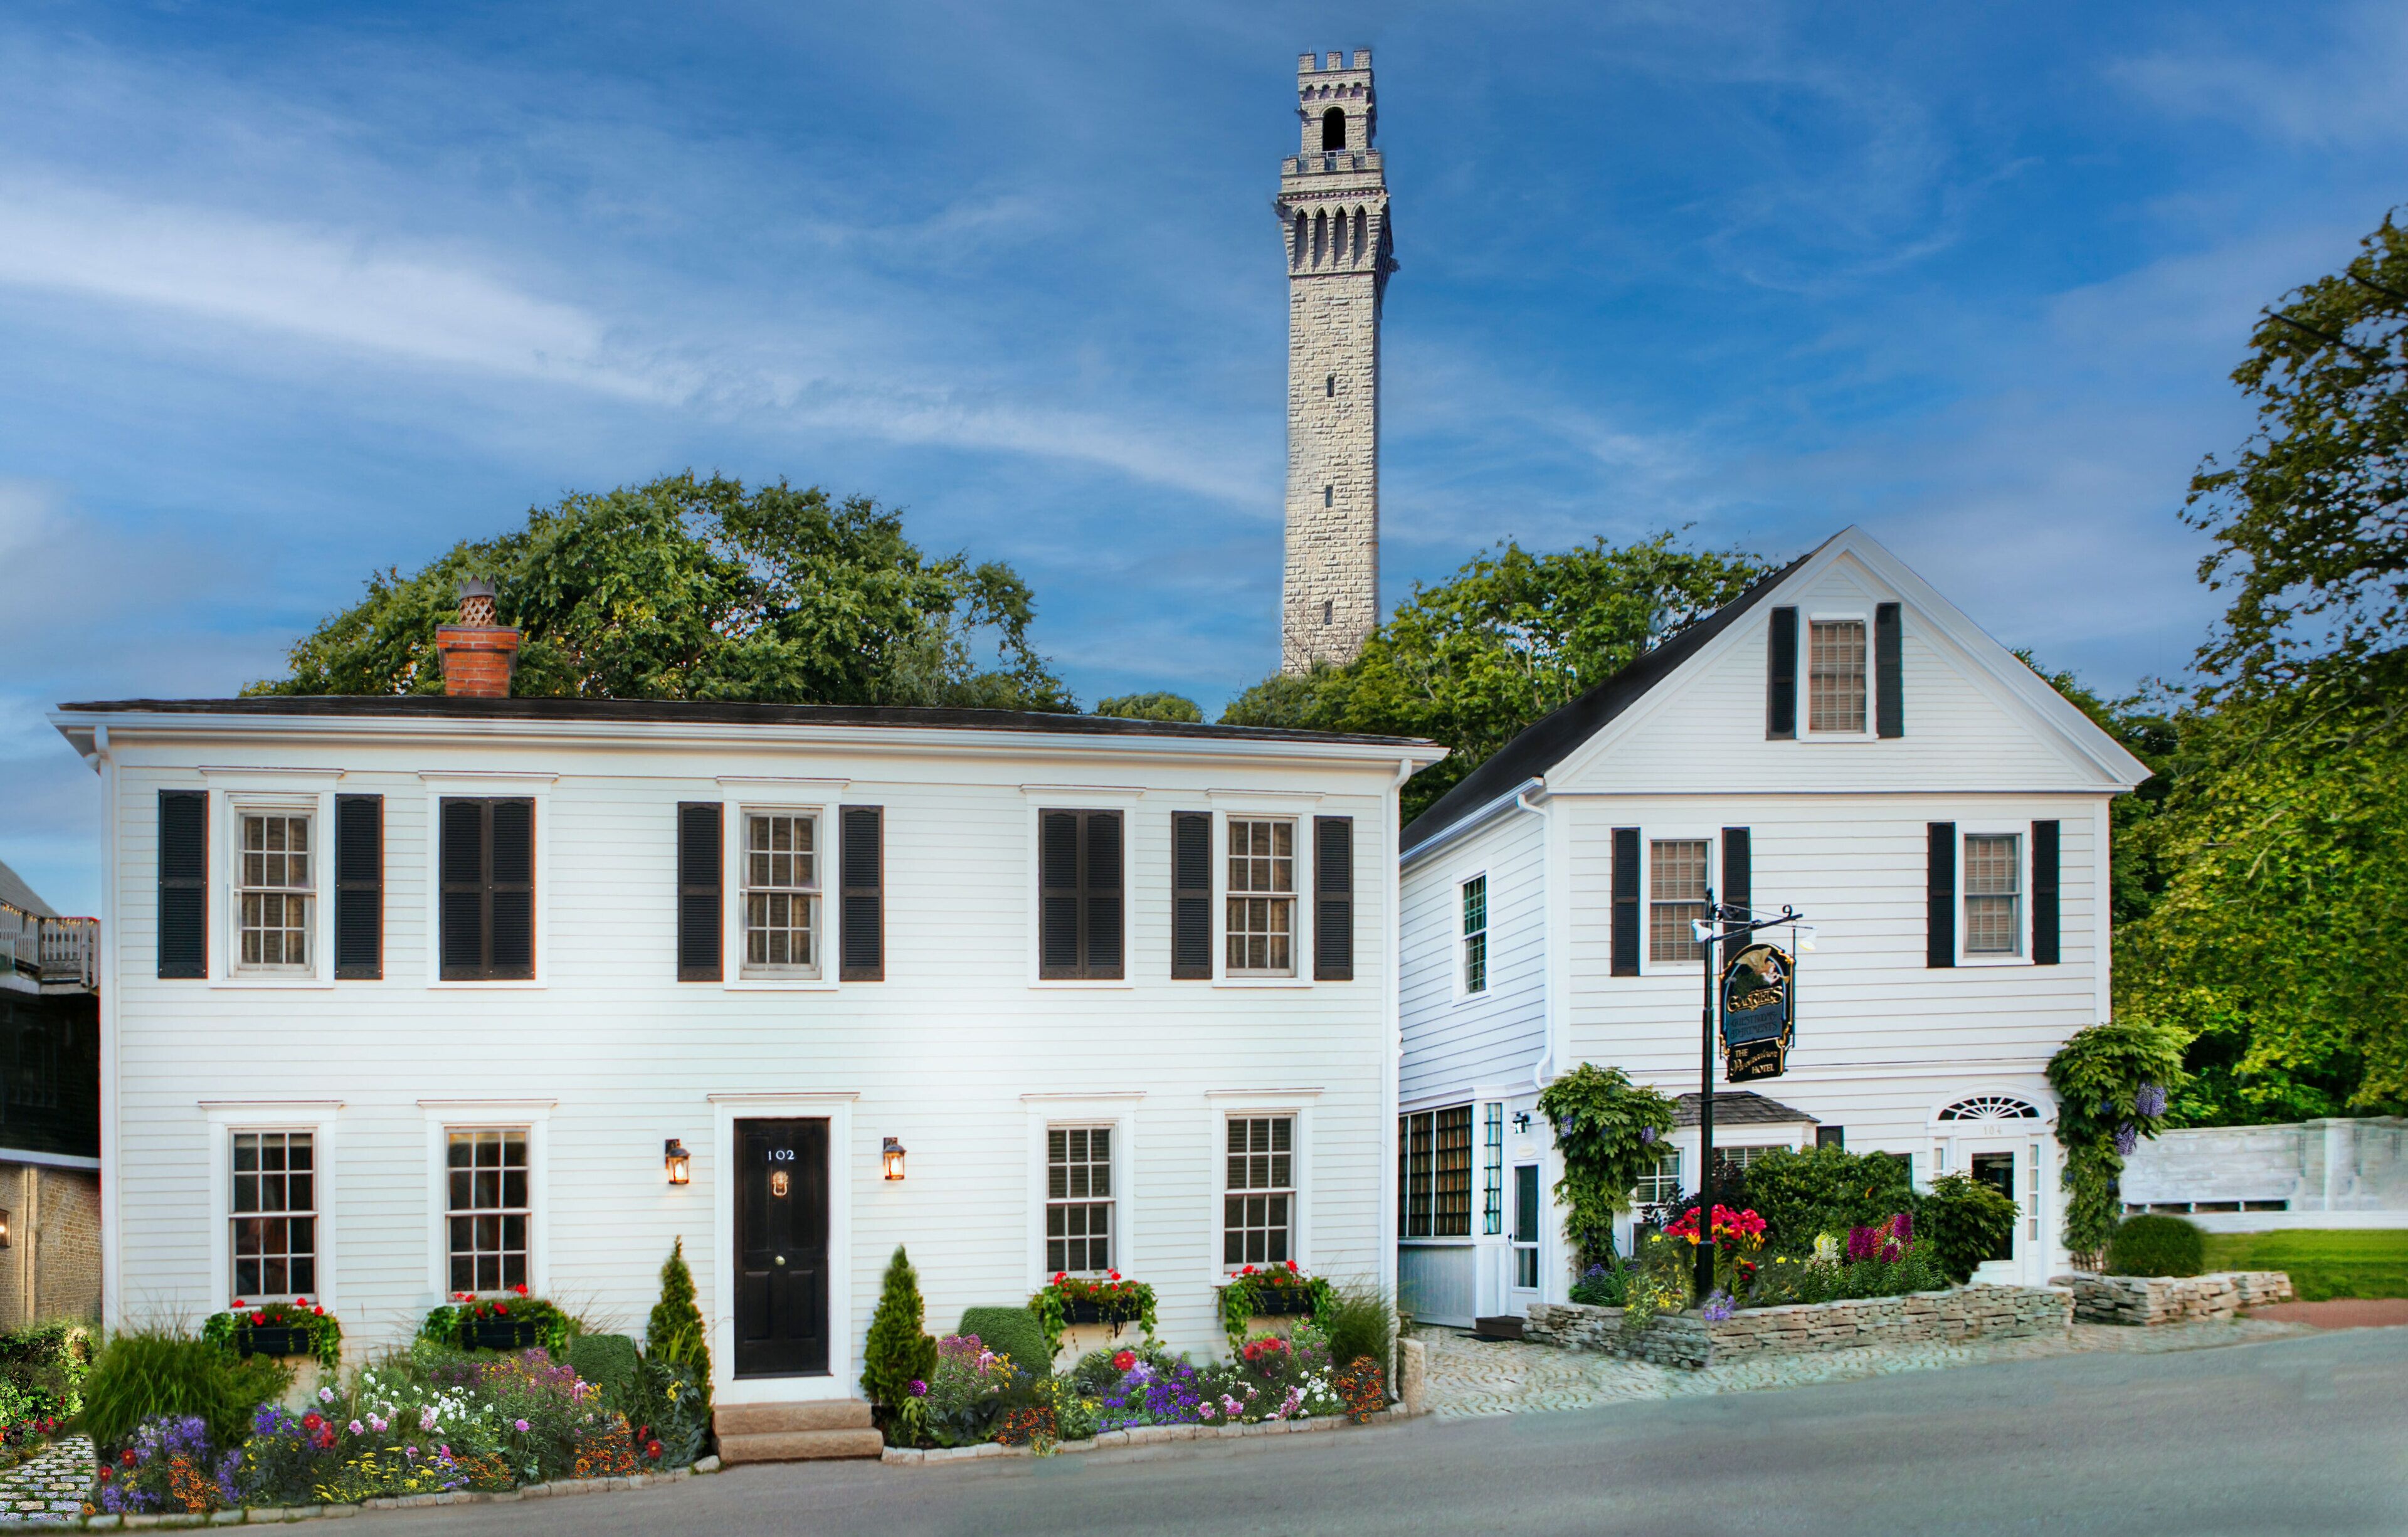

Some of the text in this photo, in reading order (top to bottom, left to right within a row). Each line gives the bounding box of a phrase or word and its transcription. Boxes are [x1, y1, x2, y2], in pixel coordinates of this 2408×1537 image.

[1735, 1048, 1748, 1057] THE
[1751, 1064, 1775, 1074] HOTEL
[1984, 1125, 2002, 1135] 104
[768, 1149, 795, 1161] 102
